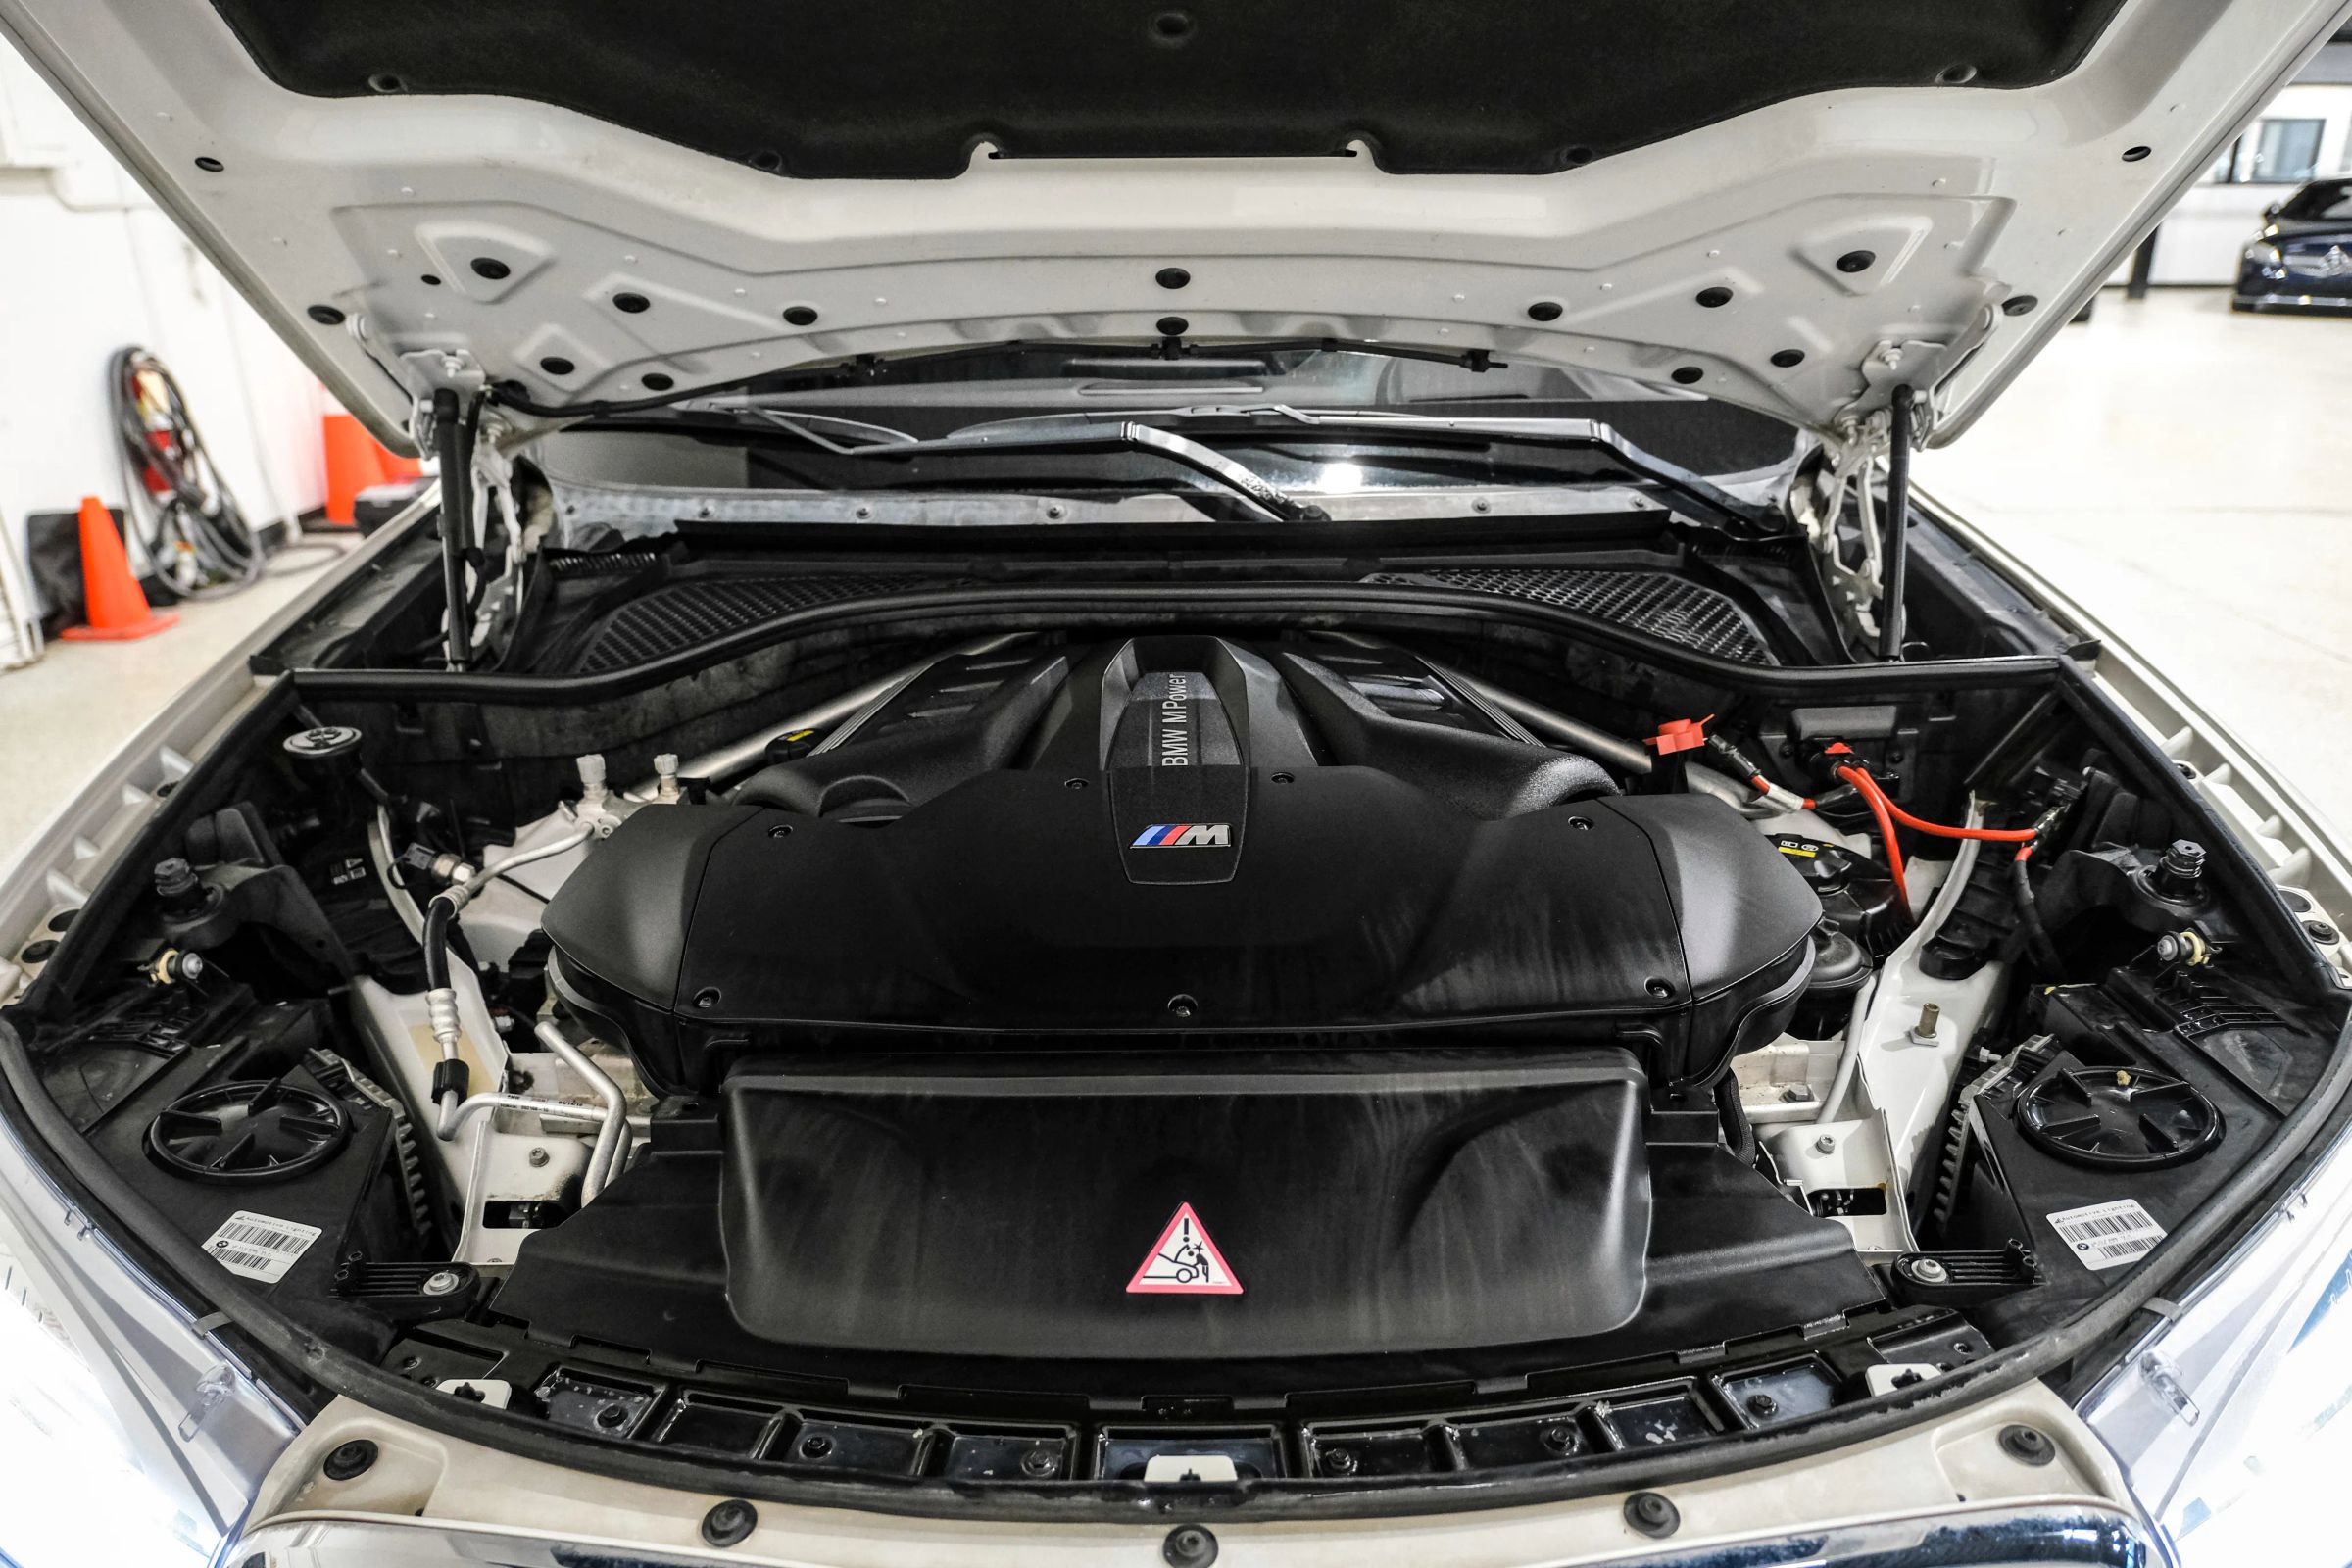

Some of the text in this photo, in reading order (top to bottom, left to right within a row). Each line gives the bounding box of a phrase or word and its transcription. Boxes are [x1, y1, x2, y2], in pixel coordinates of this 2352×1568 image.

[1161, 728, 1189, 767] BMW
[2062, 1203, 2135, 1221] Automotive Lighting
[245, 1216, 317, 1237] Automotive Lighting
